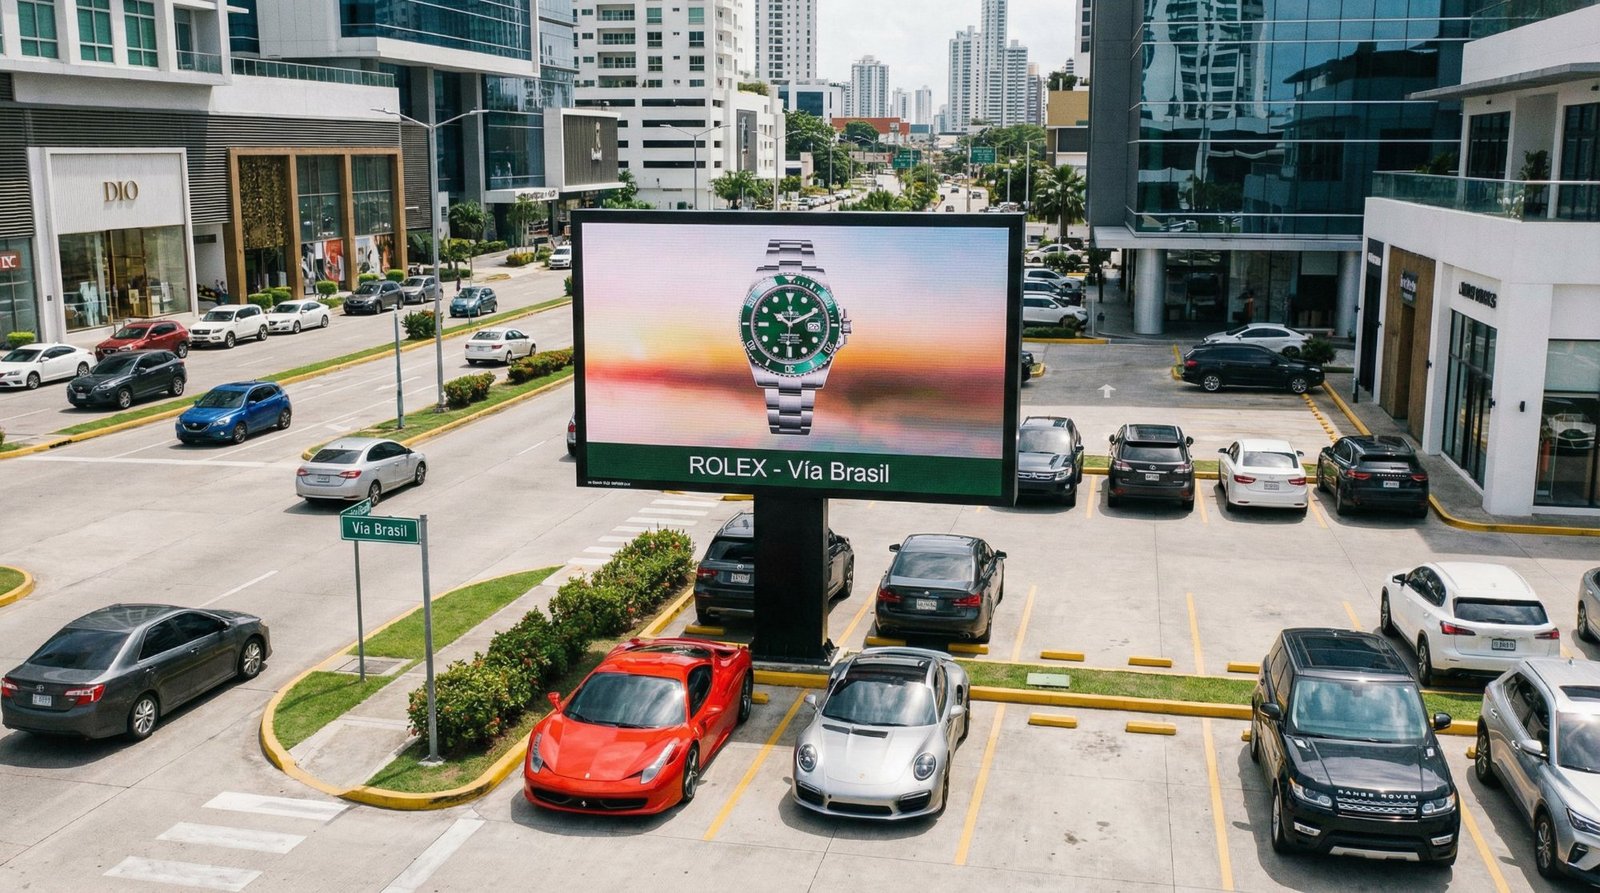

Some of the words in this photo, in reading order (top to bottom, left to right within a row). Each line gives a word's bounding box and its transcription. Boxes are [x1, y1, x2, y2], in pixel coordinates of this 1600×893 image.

[103, 180, 139, 202] DIO
[689, 455, 768, 478] ROLEX
[787, 459, 823, 480] Vía
[830, 461, 890, 484] Brasil
[374, 522, 408, 537] Brasil
[1338, 789, 1374, 798] RANGE
